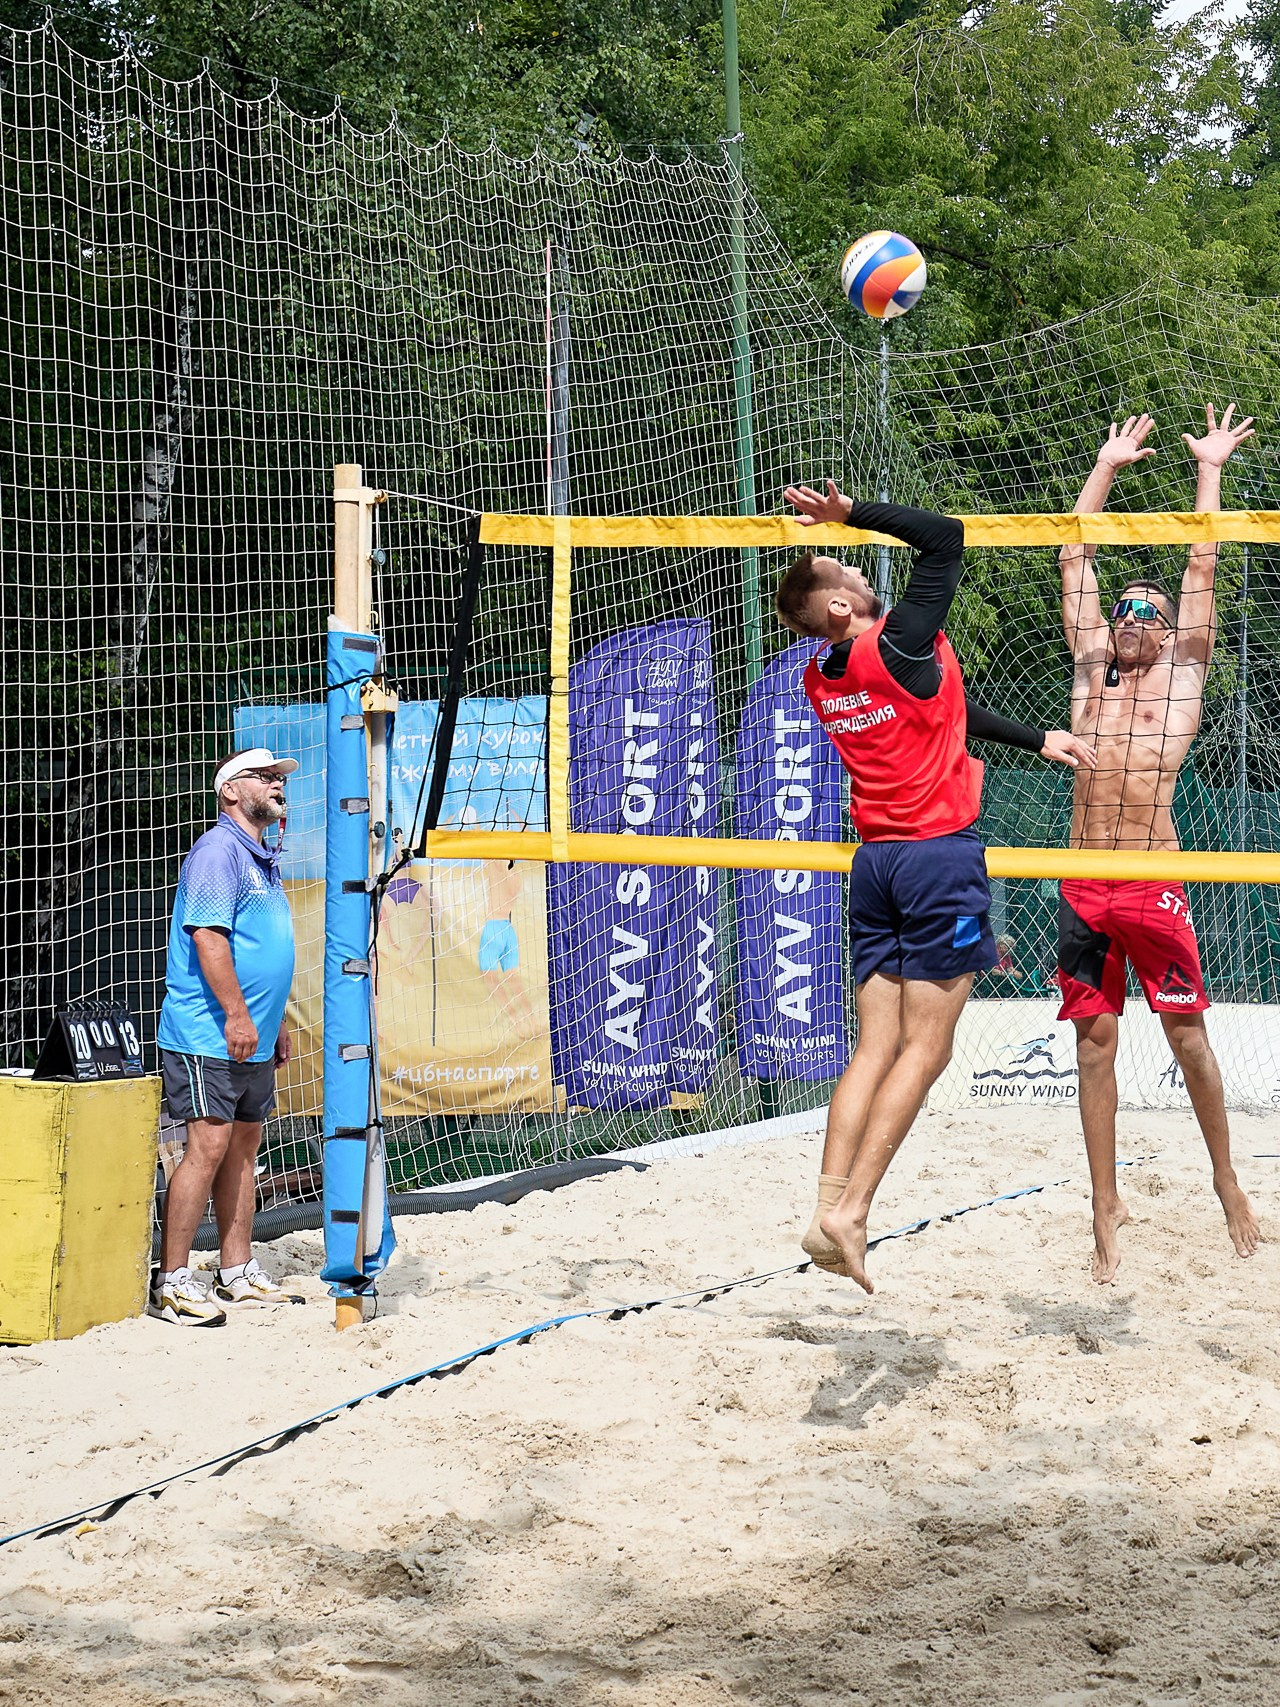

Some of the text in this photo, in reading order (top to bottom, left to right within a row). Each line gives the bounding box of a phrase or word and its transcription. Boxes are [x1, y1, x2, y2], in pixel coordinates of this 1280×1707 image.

[605, 698, 659, 1050] AYV SORT
[774, 912, 812, 1024] AYV
[69, 1023, 92, 1060] 20
[118, 1020, 140, 1056] 13
[754, 1033, 836, 1049] SUNNY WIND
[795, 1050, 834, 1062] COURTS
[581, 1059, 668, 1078] SUNNY WIND
[969, 1084, 1077, 1098] SUNNY WIND
